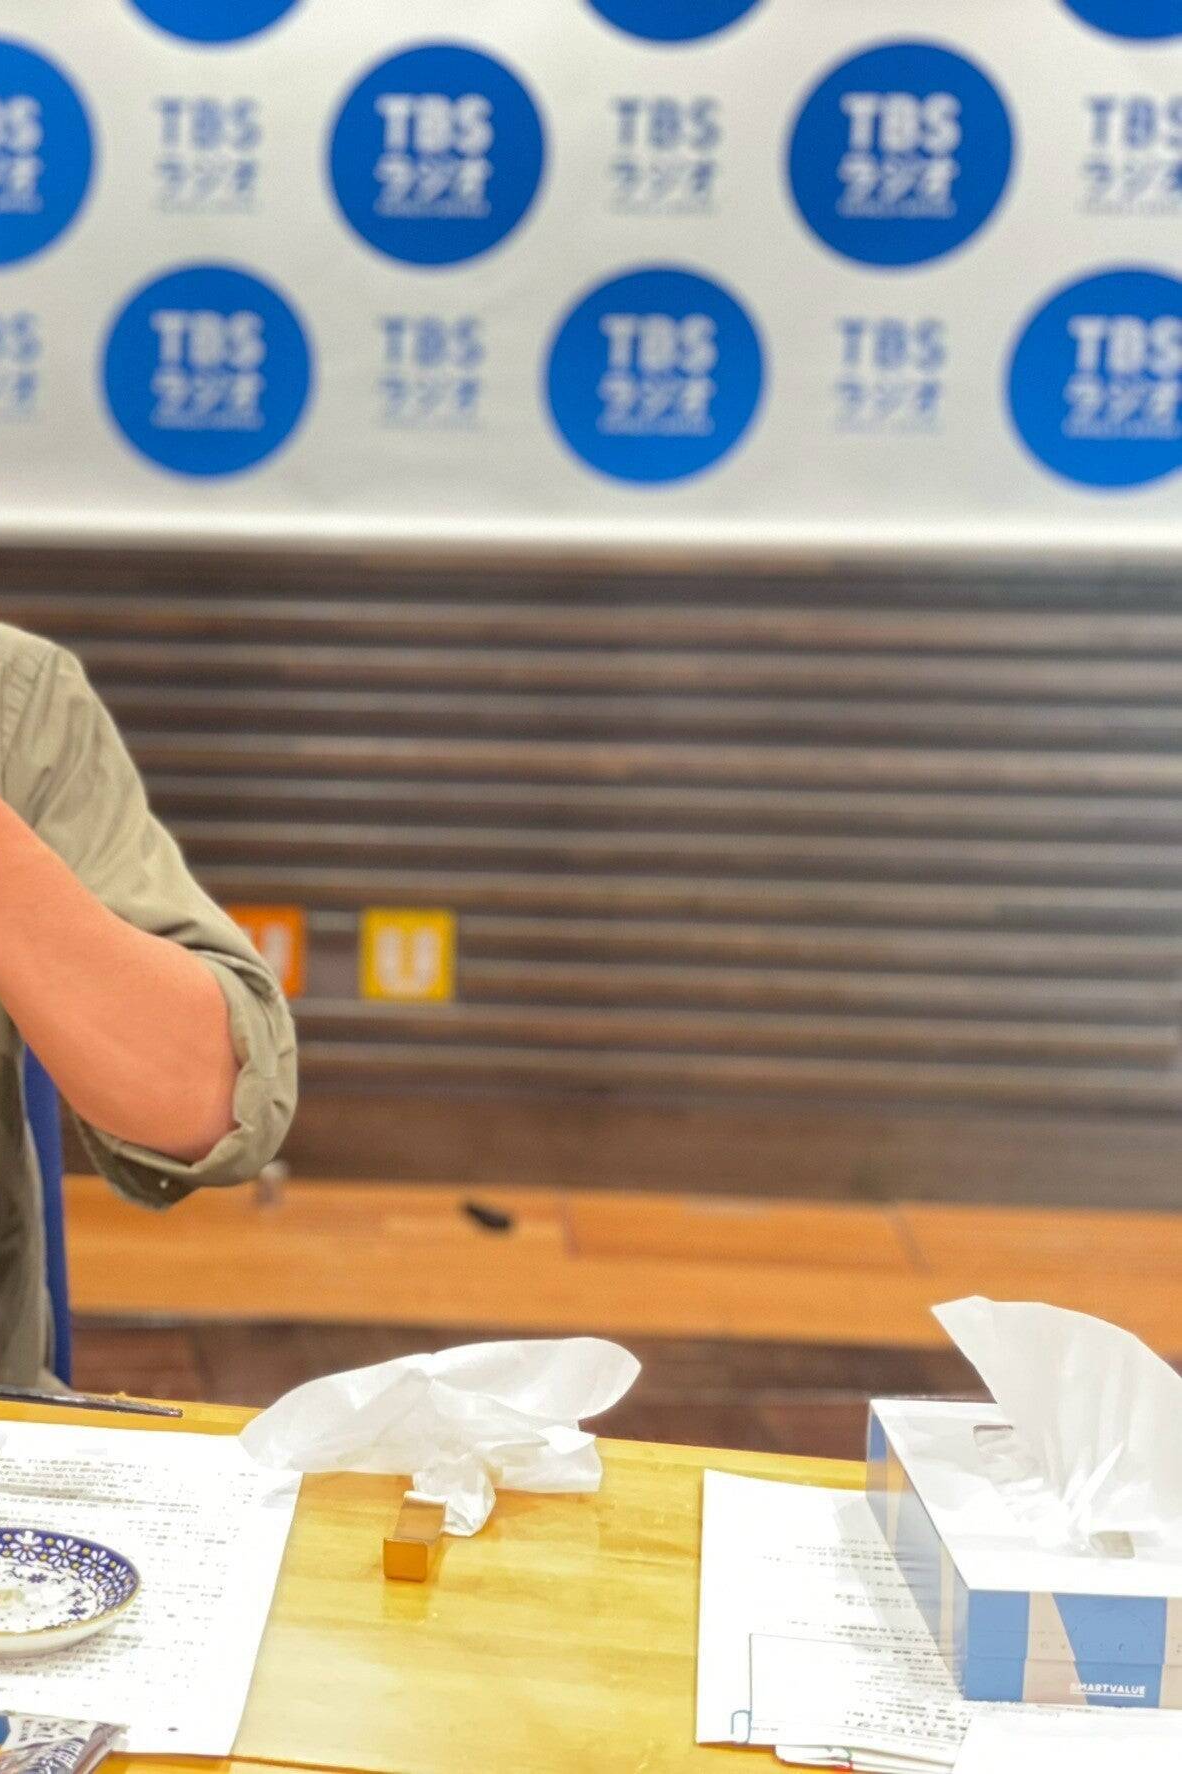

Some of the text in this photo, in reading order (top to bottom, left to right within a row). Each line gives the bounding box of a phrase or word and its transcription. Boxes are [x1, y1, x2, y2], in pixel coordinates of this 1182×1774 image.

[154, 98, 260, 151] TBS
[375, 94, 494, 155] TBS
[611, 100, 722, 151] TBS
[840, 93, 962, 153] TBS
[150, 311, 265, 368] TBS
[380, 317, 485, 368] TBS
[599, 314, 717, 373] TBS
[836, 322, 947, 369] TBS
[1067, 316, 1182, 375] TBS
[1070, 1683, 1146, 1696] SMARTVALUE
